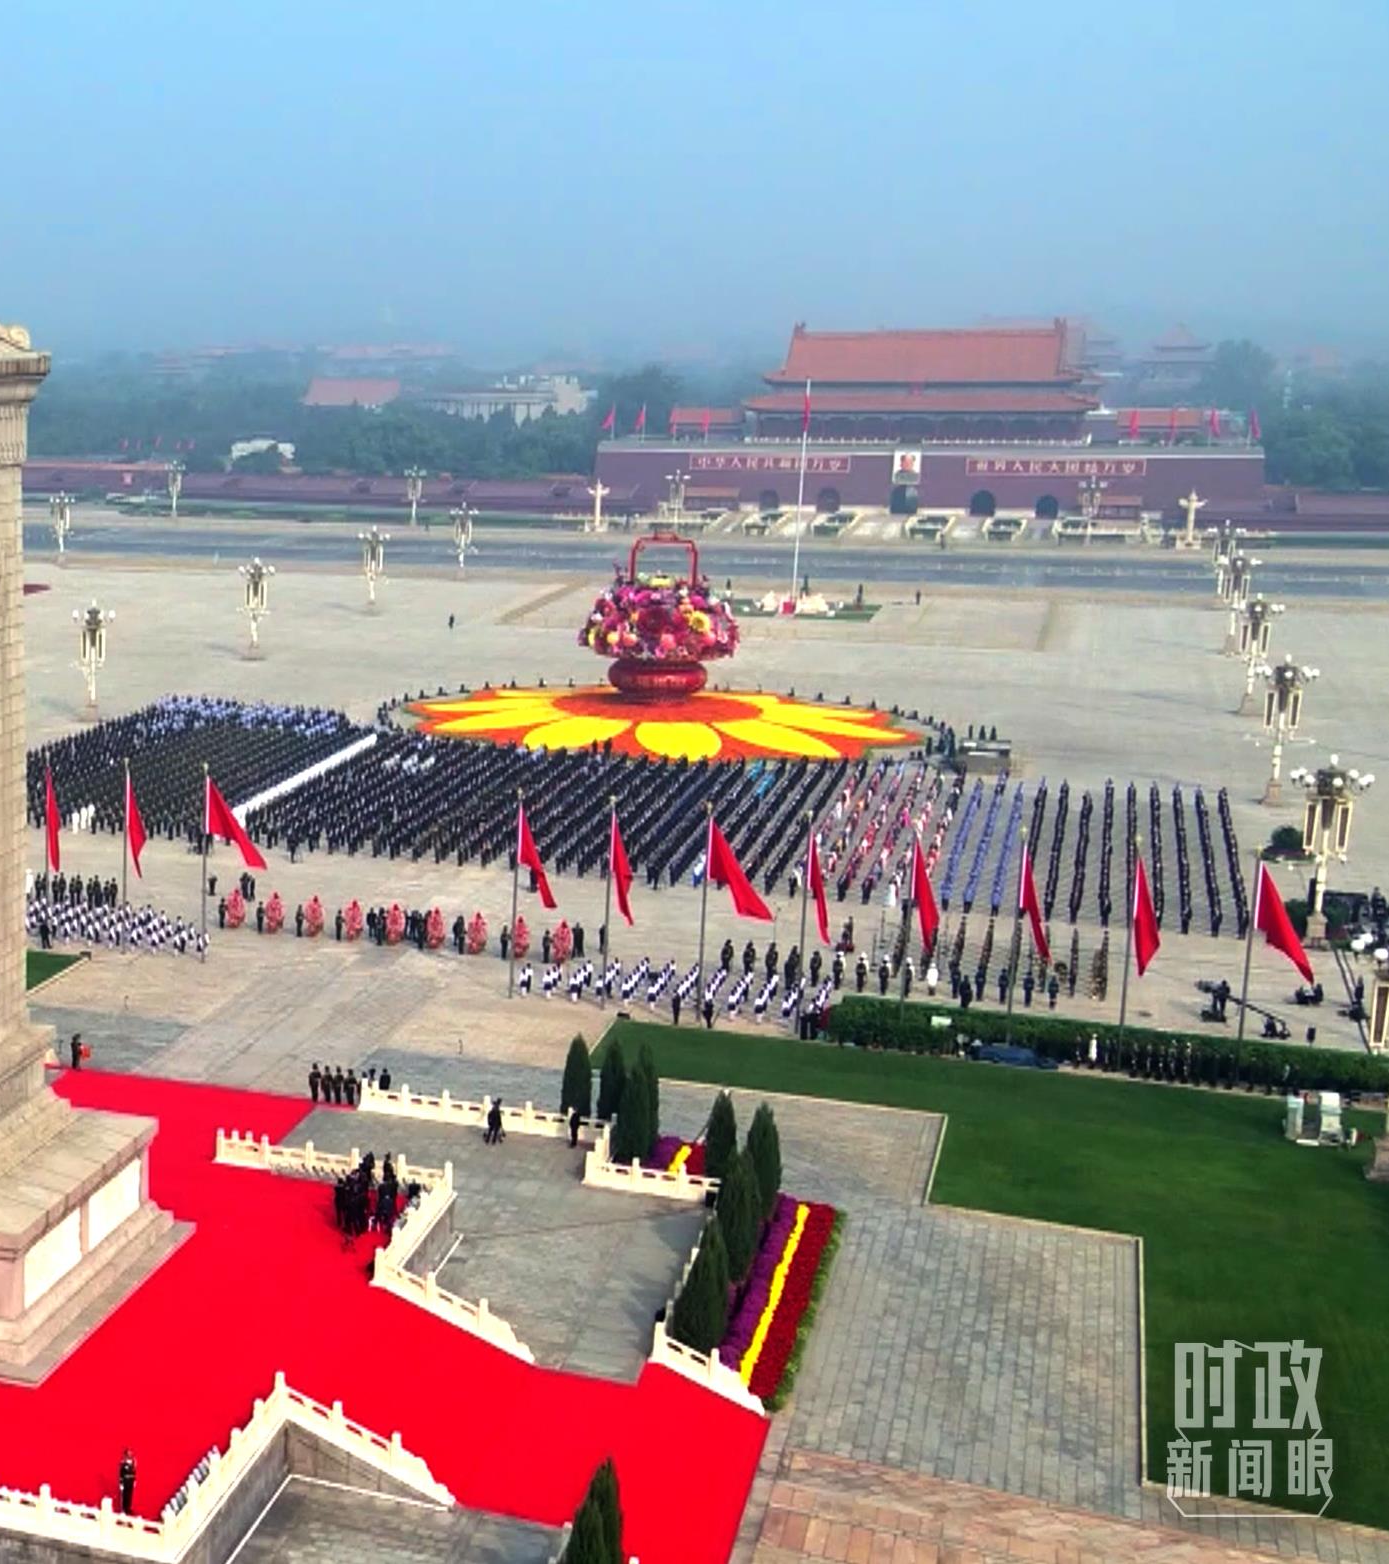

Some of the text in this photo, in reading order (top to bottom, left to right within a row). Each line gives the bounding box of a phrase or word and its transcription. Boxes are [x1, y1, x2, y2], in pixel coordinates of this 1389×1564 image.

[976, 458, 1136, 475] 世界人民大团结万岁
